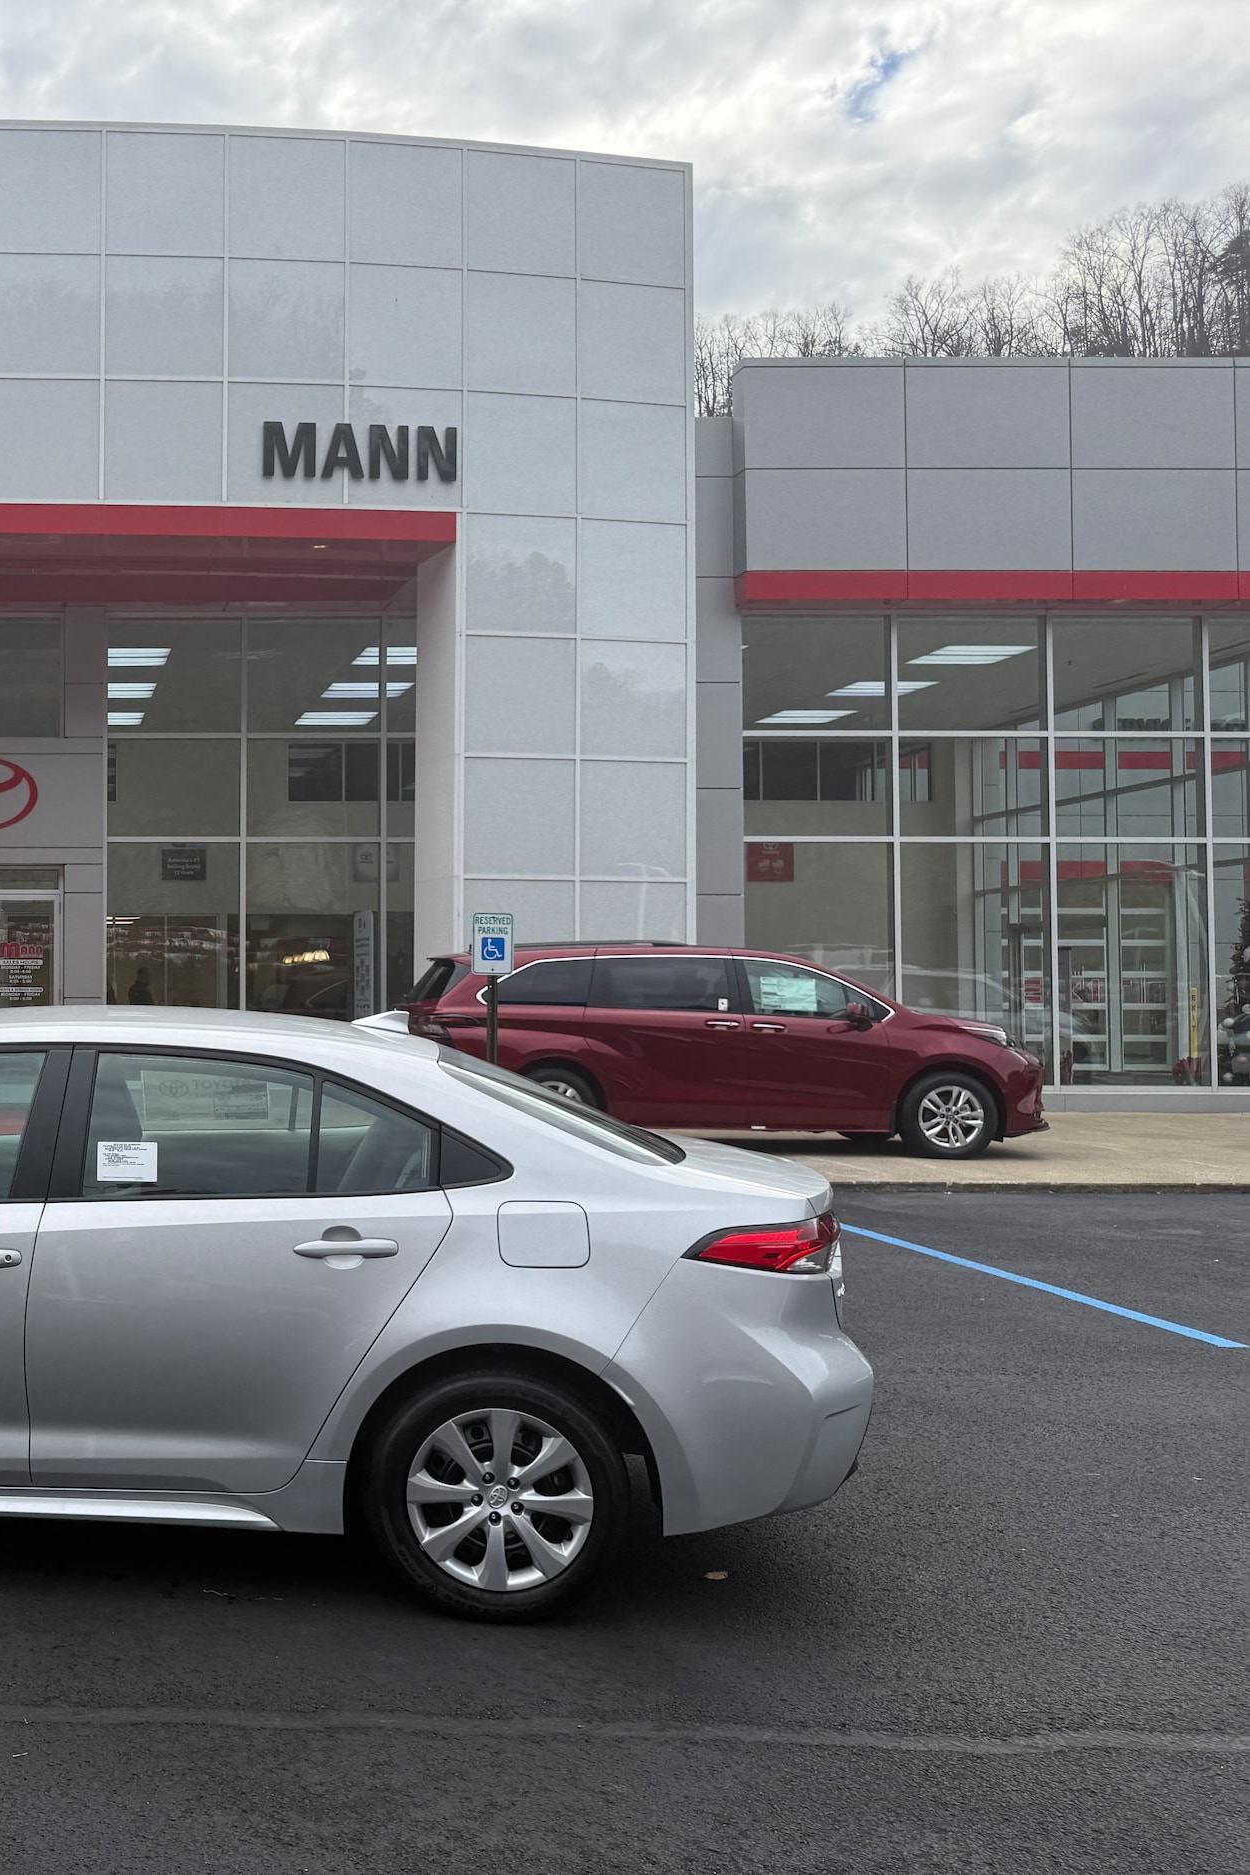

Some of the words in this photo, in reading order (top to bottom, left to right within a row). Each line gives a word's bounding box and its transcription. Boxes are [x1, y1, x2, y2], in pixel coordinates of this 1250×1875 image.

[262, 421, 457, 482] MANN
[475, 916, 511, 925] RESERVED
[477, 926, 509, 935] PARKING
